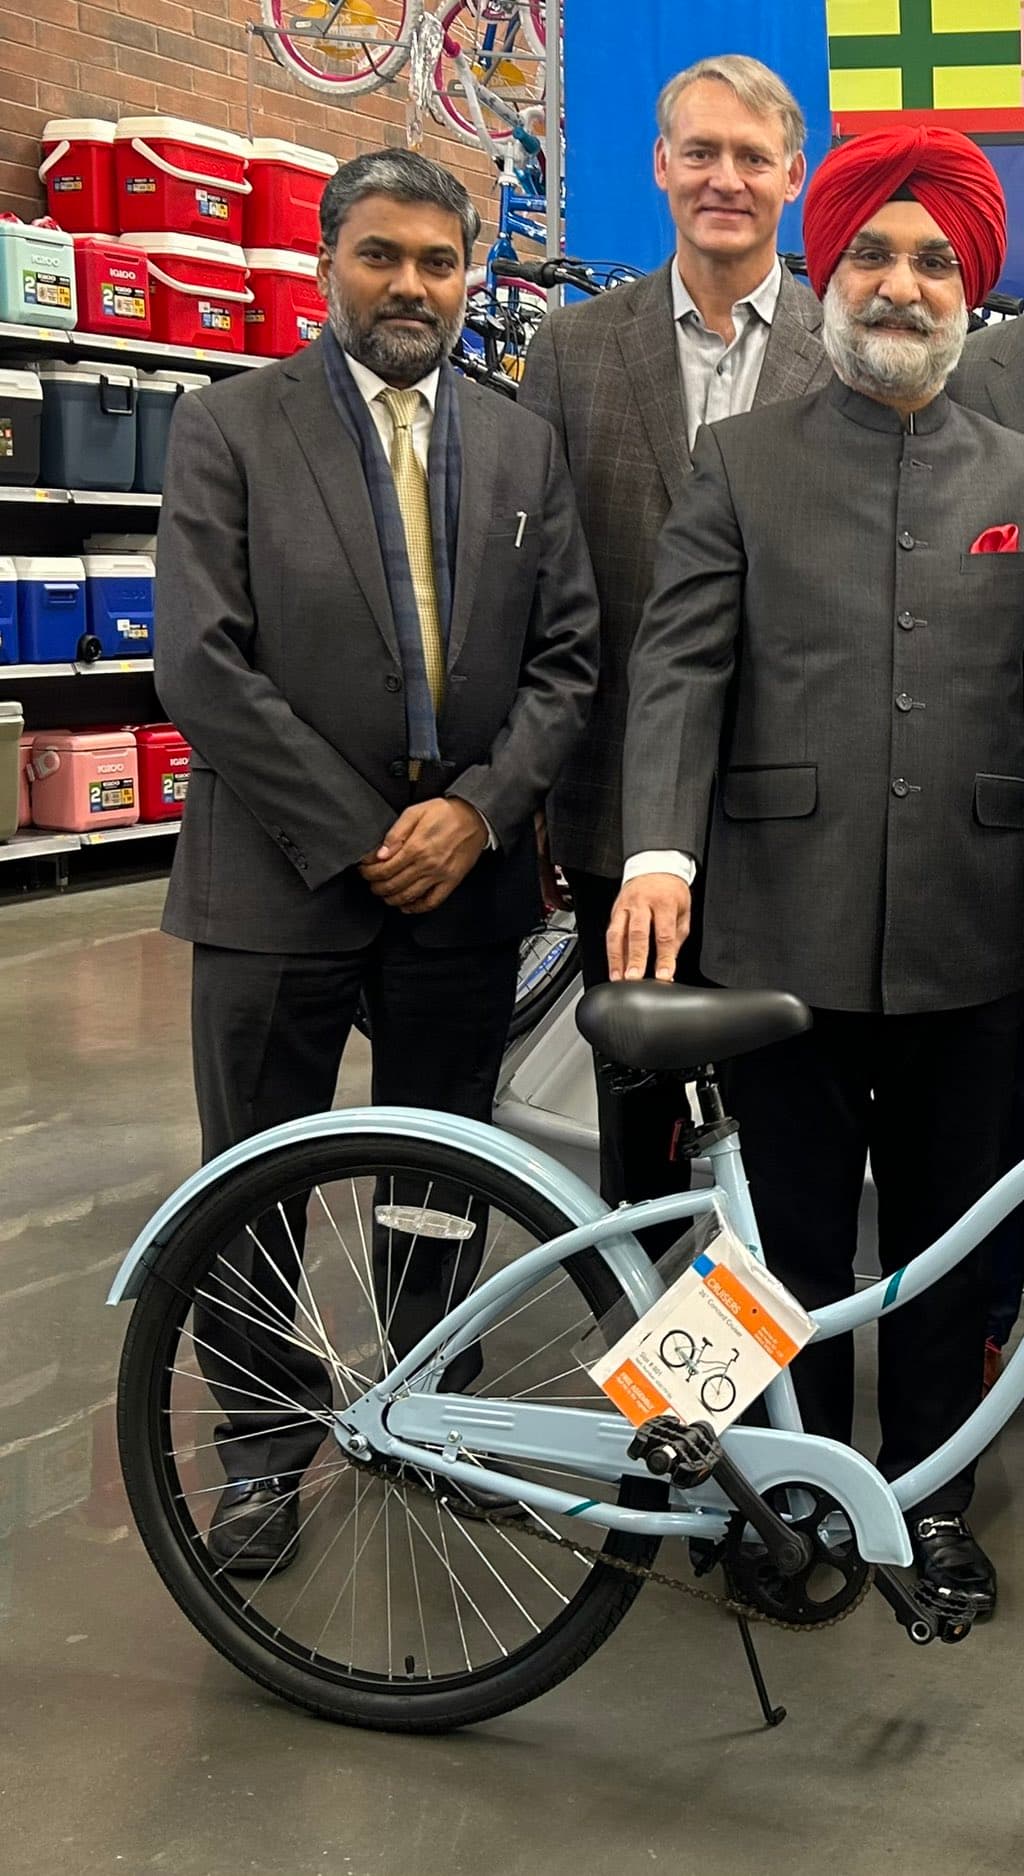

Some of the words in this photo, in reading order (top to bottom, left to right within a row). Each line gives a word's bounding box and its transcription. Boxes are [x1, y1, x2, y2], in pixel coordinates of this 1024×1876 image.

[109, 268, 136, 280] IGLOO
[25, 276, 36, 293] 2
[102, 288, 113, 306] 2
[170, 757, 189, 766] IGLO
[90, 787, 101, 803] 2
